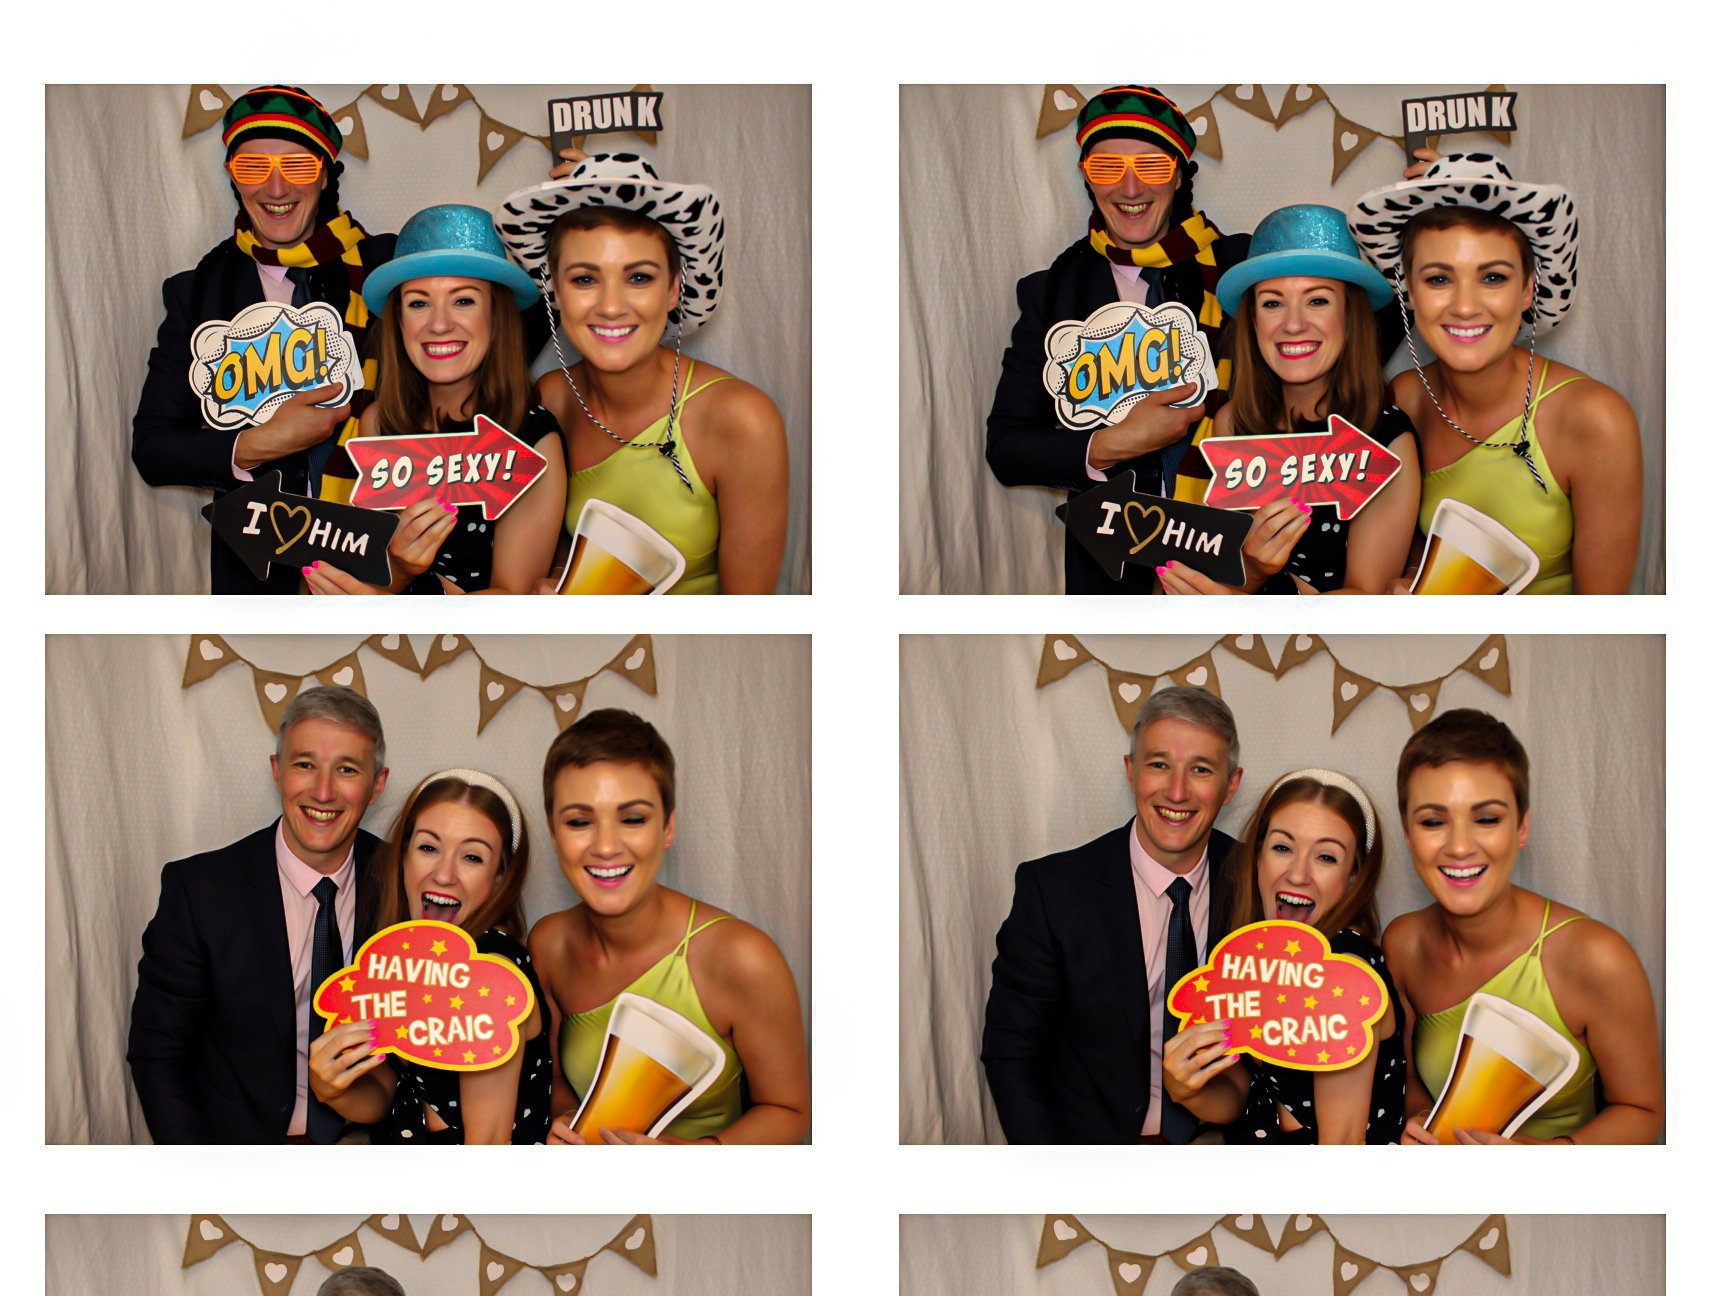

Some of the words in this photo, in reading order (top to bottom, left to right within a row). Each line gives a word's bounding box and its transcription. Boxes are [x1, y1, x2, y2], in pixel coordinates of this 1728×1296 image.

[552, 96, 658, 132] DRUNK
[1406, 96, 1512, 132] DRUNK
[212, 328, 329, 404] OMG!
[1066, 328, 1183, 404] OMG!
[370, 456, 414, 490] SO
[426, 449, 517, 486] SEXY!
[1224, 456, 1268, 490] SO
[1280, 449, 1371, 486] SEXY!
[242, 501, 268, 535] I
[307, 520, 371, 556] HIM
[1096, 501, 1122, 535] I
[1161, 520, 1225, 556] HIM
[367, 953, 470, 989] HAVING
[1221, 953, 1324, 989] HAVING
[351, 990, 408, 1020] THE
[1205, 990, 1262, 1020] THE
[408, 1014, 494, 1046] CRAIC
[1262, 1014, 1348, 1046] CRAIC
